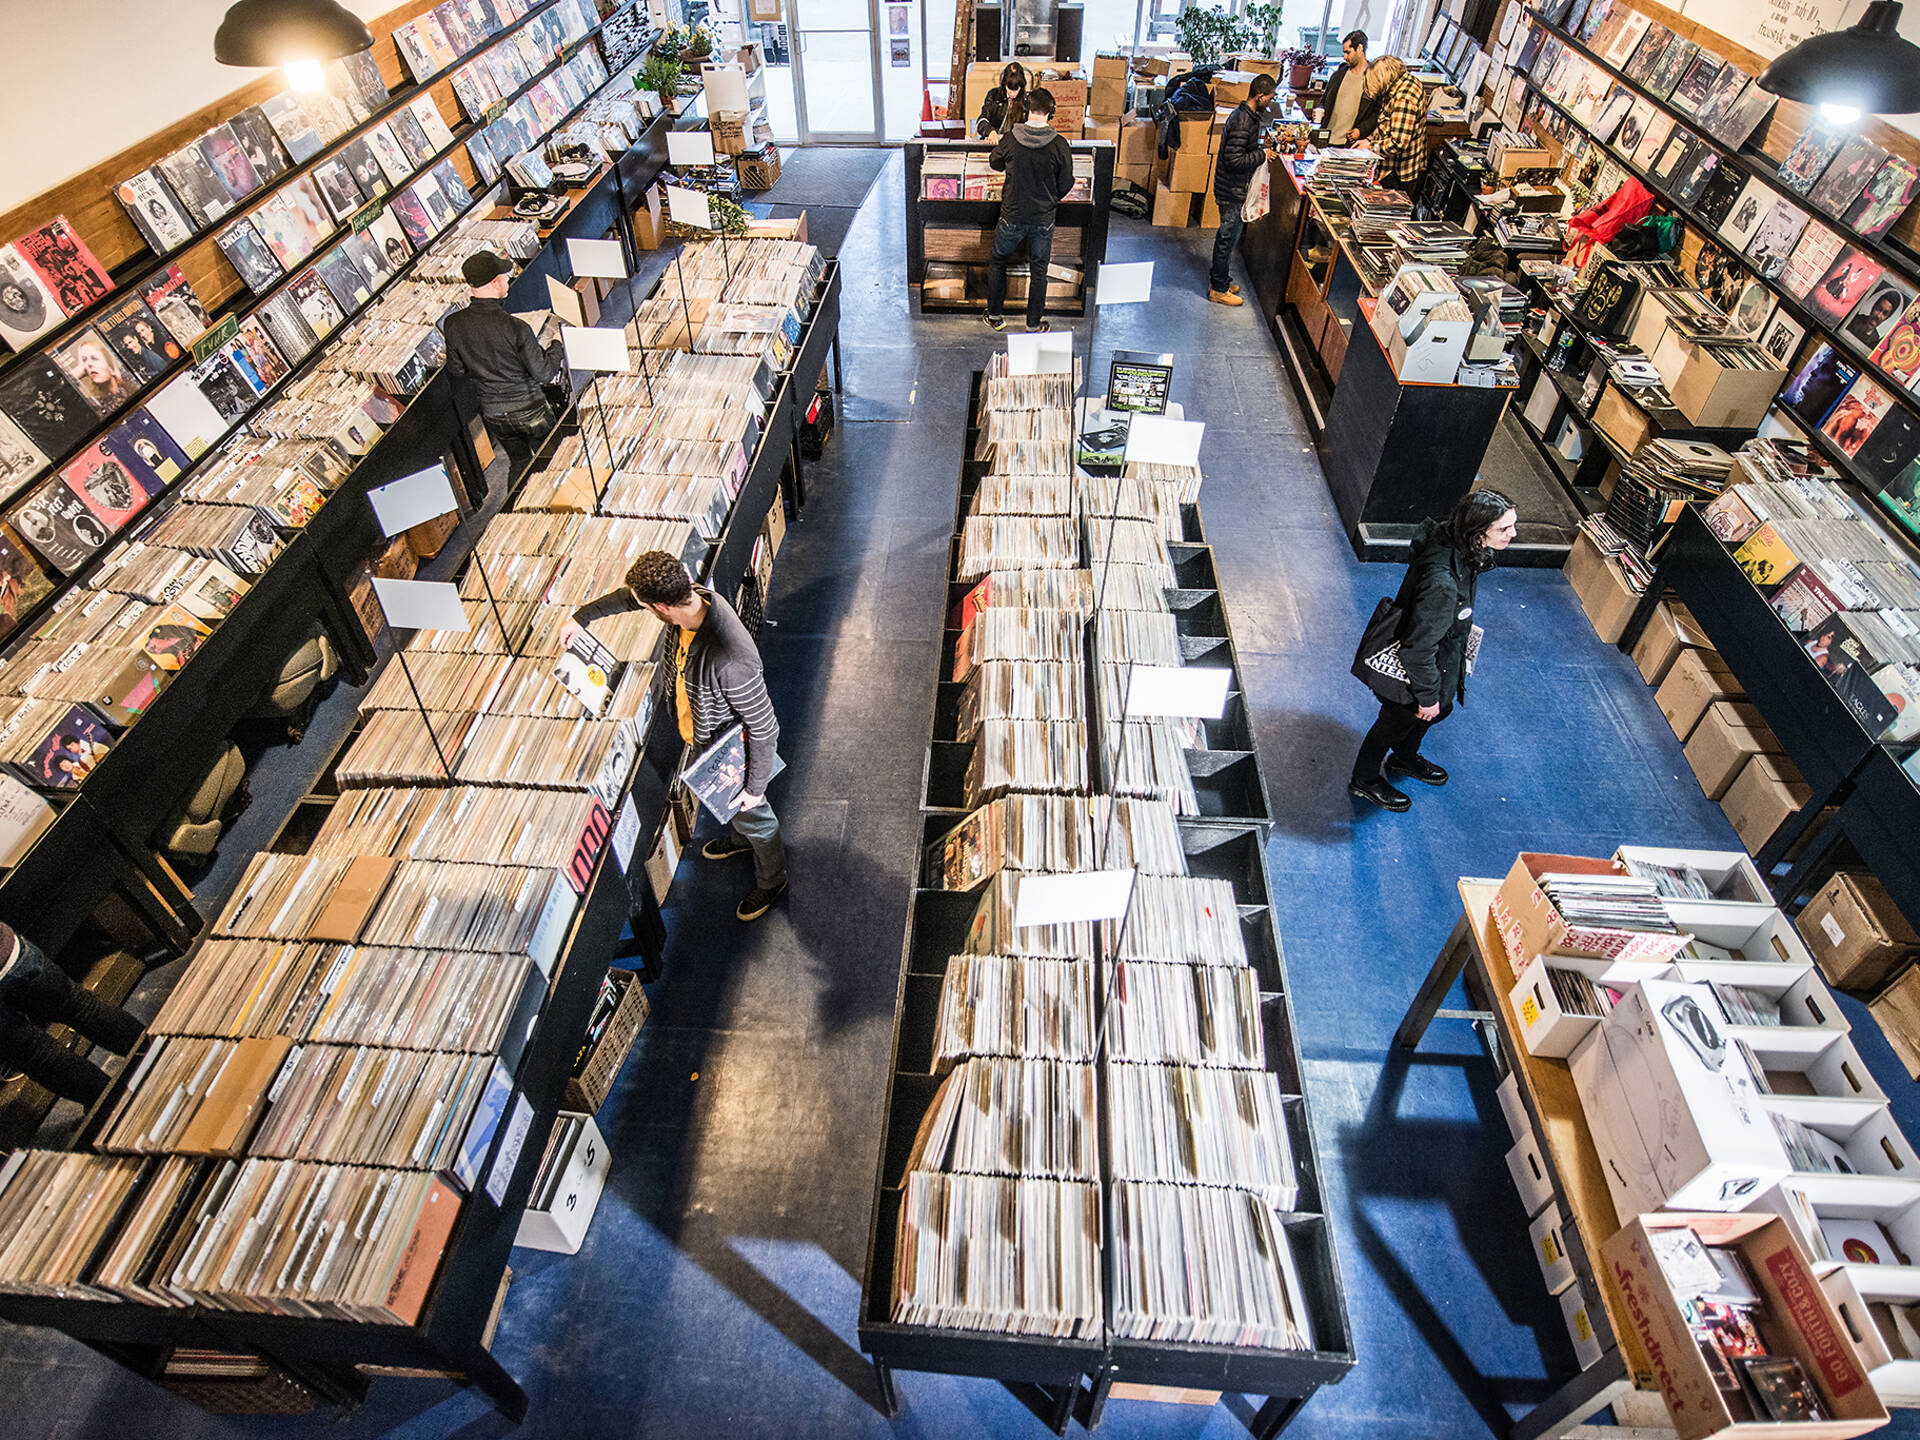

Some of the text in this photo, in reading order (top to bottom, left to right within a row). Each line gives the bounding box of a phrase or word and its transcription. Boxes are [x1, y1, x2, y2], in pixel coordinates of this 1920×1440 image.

[200, 325, 230, 358] PUNK
[32, 495, 50, 511] SIX
[47, 496, 65, 516] FEET
[60, 499, 84, 520] UNDER
[1778, 1261, 1804, 1298] COZY
[1615, 1261, 1685, 1415] freshdirect
[1803, 1310, 1836, 1358] FORTH
[1830, 1360, 1849, 1382] GO
